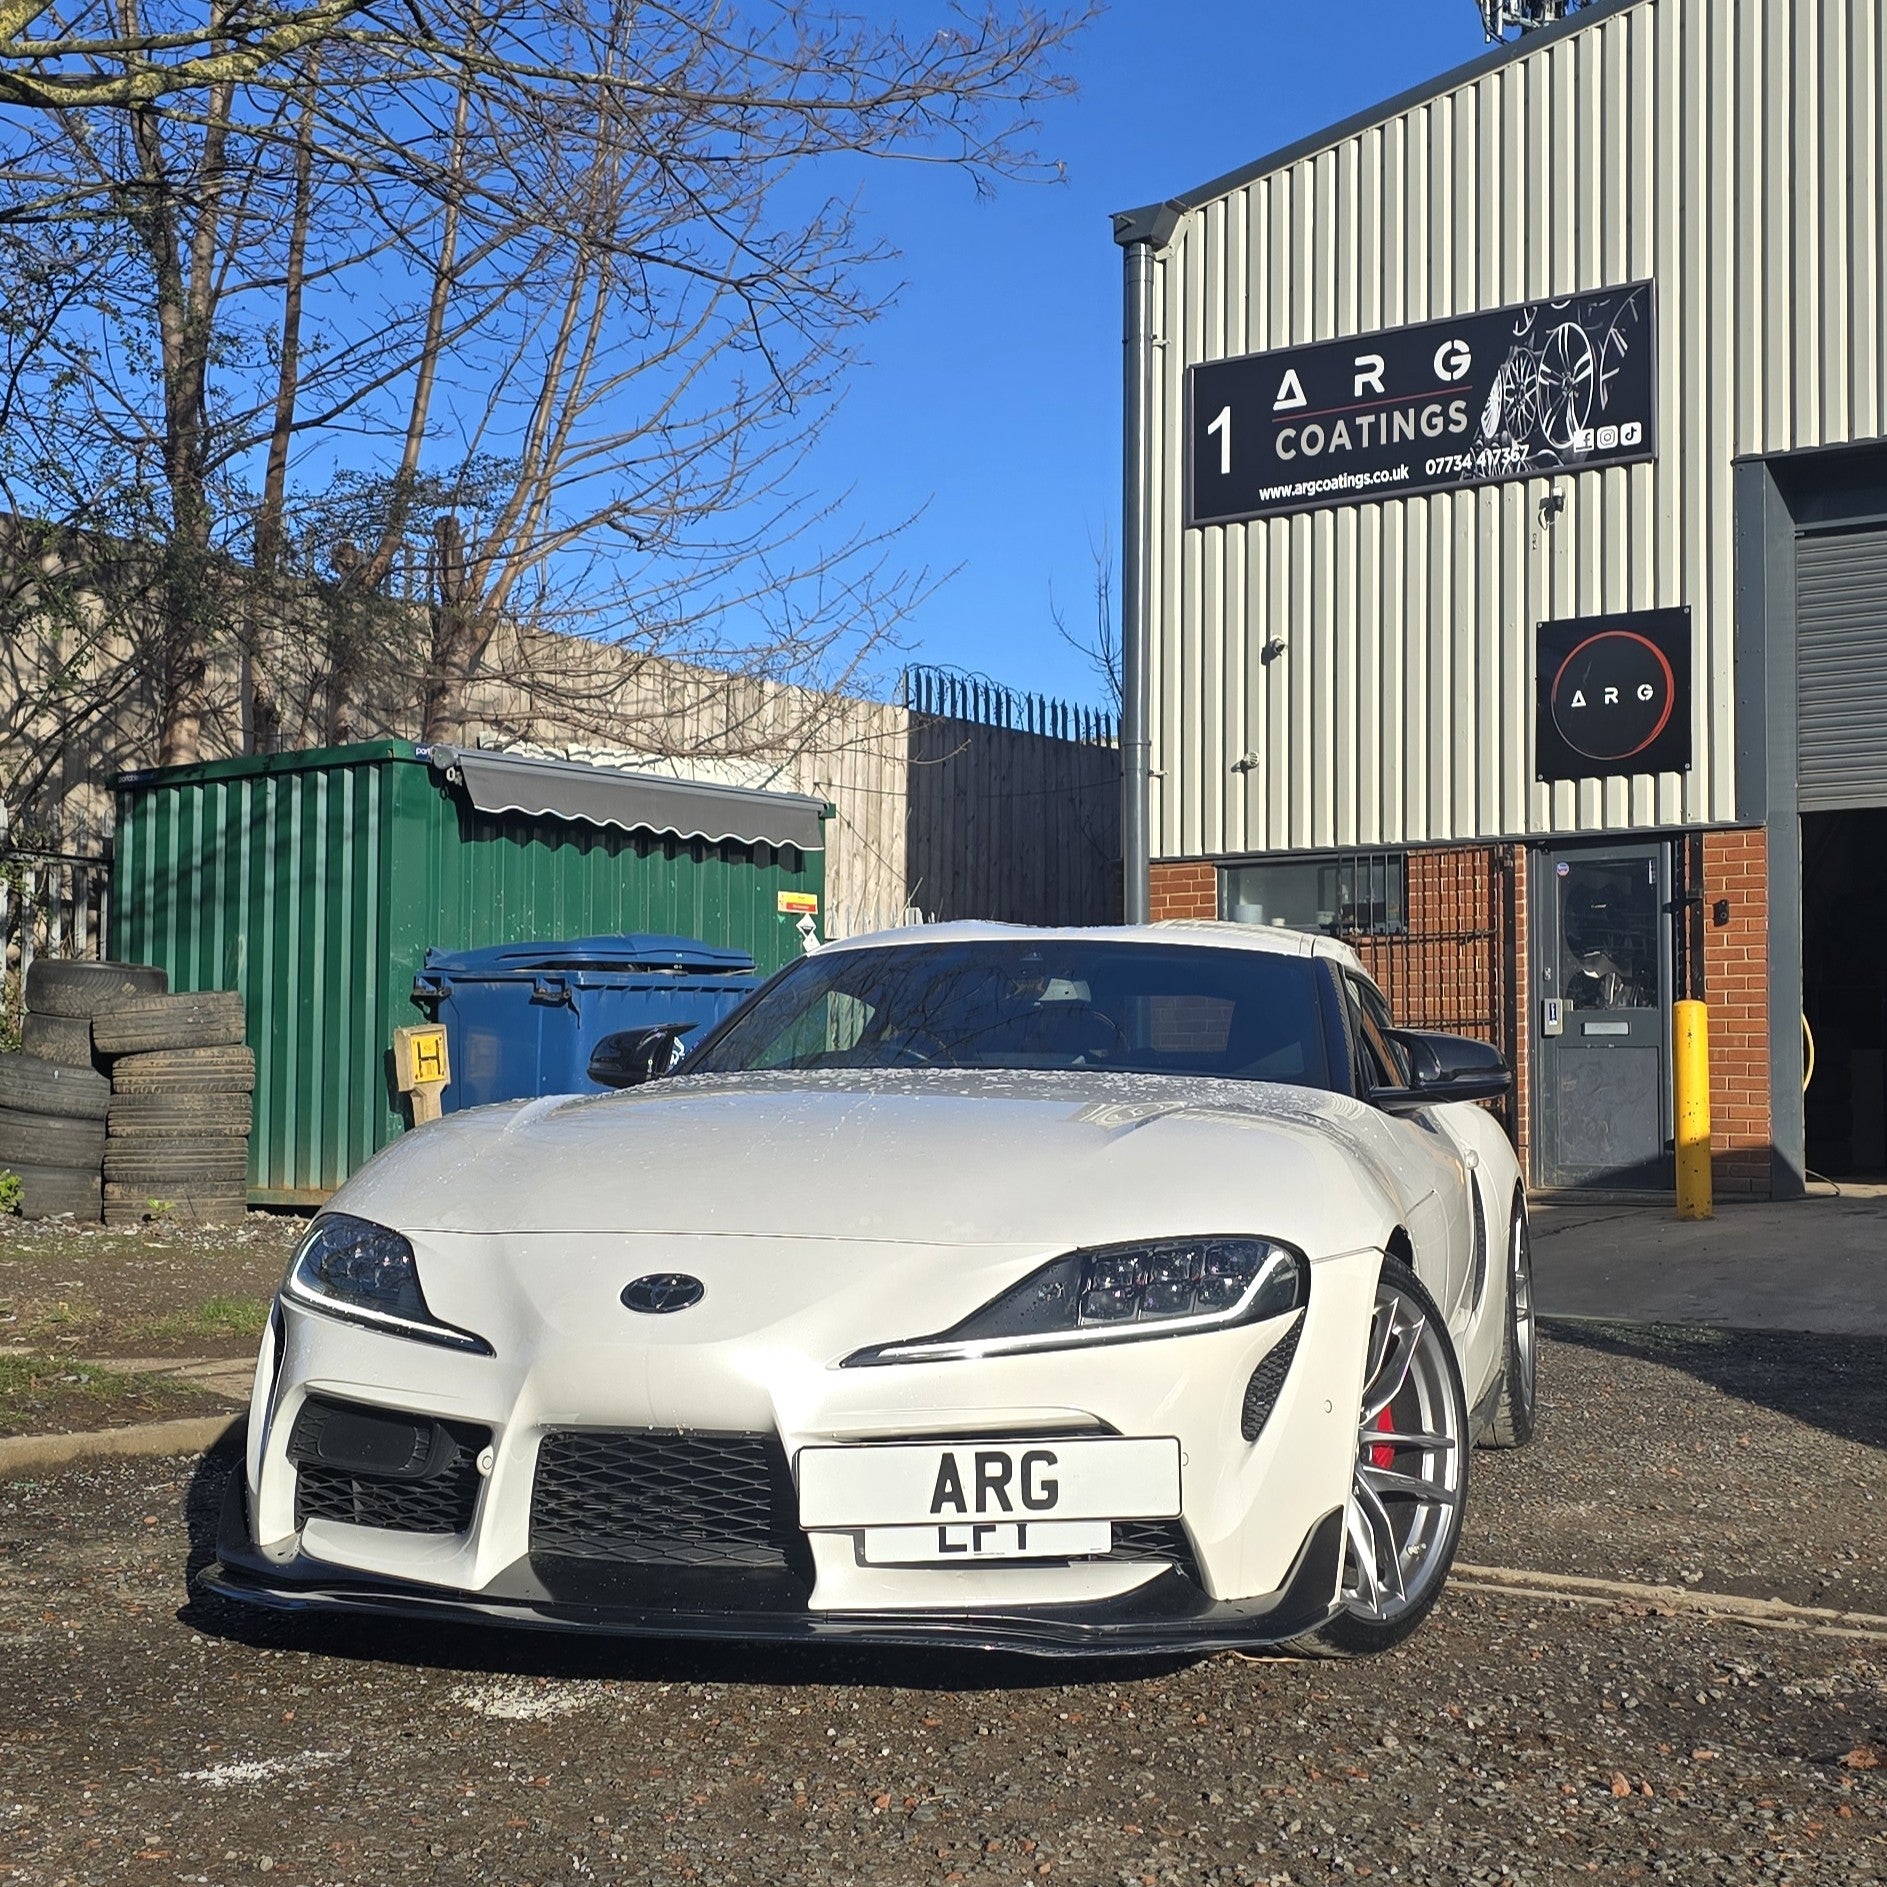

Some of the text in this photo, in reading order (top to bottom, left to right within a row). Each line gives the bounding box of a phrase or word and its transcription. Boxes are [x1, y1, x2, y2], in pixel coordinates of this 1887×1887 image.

[1207, 406, 1232, 475] 1
[1275, 400, 1468, 461] COATINGS
[1259, 464, 1409, 500] www.argcoatings.co.uk
[1425, 452, 1473, 475] 07734
[417, 1039, 441, 1078] H
[930, 1450, 1059, 1514] ARG
